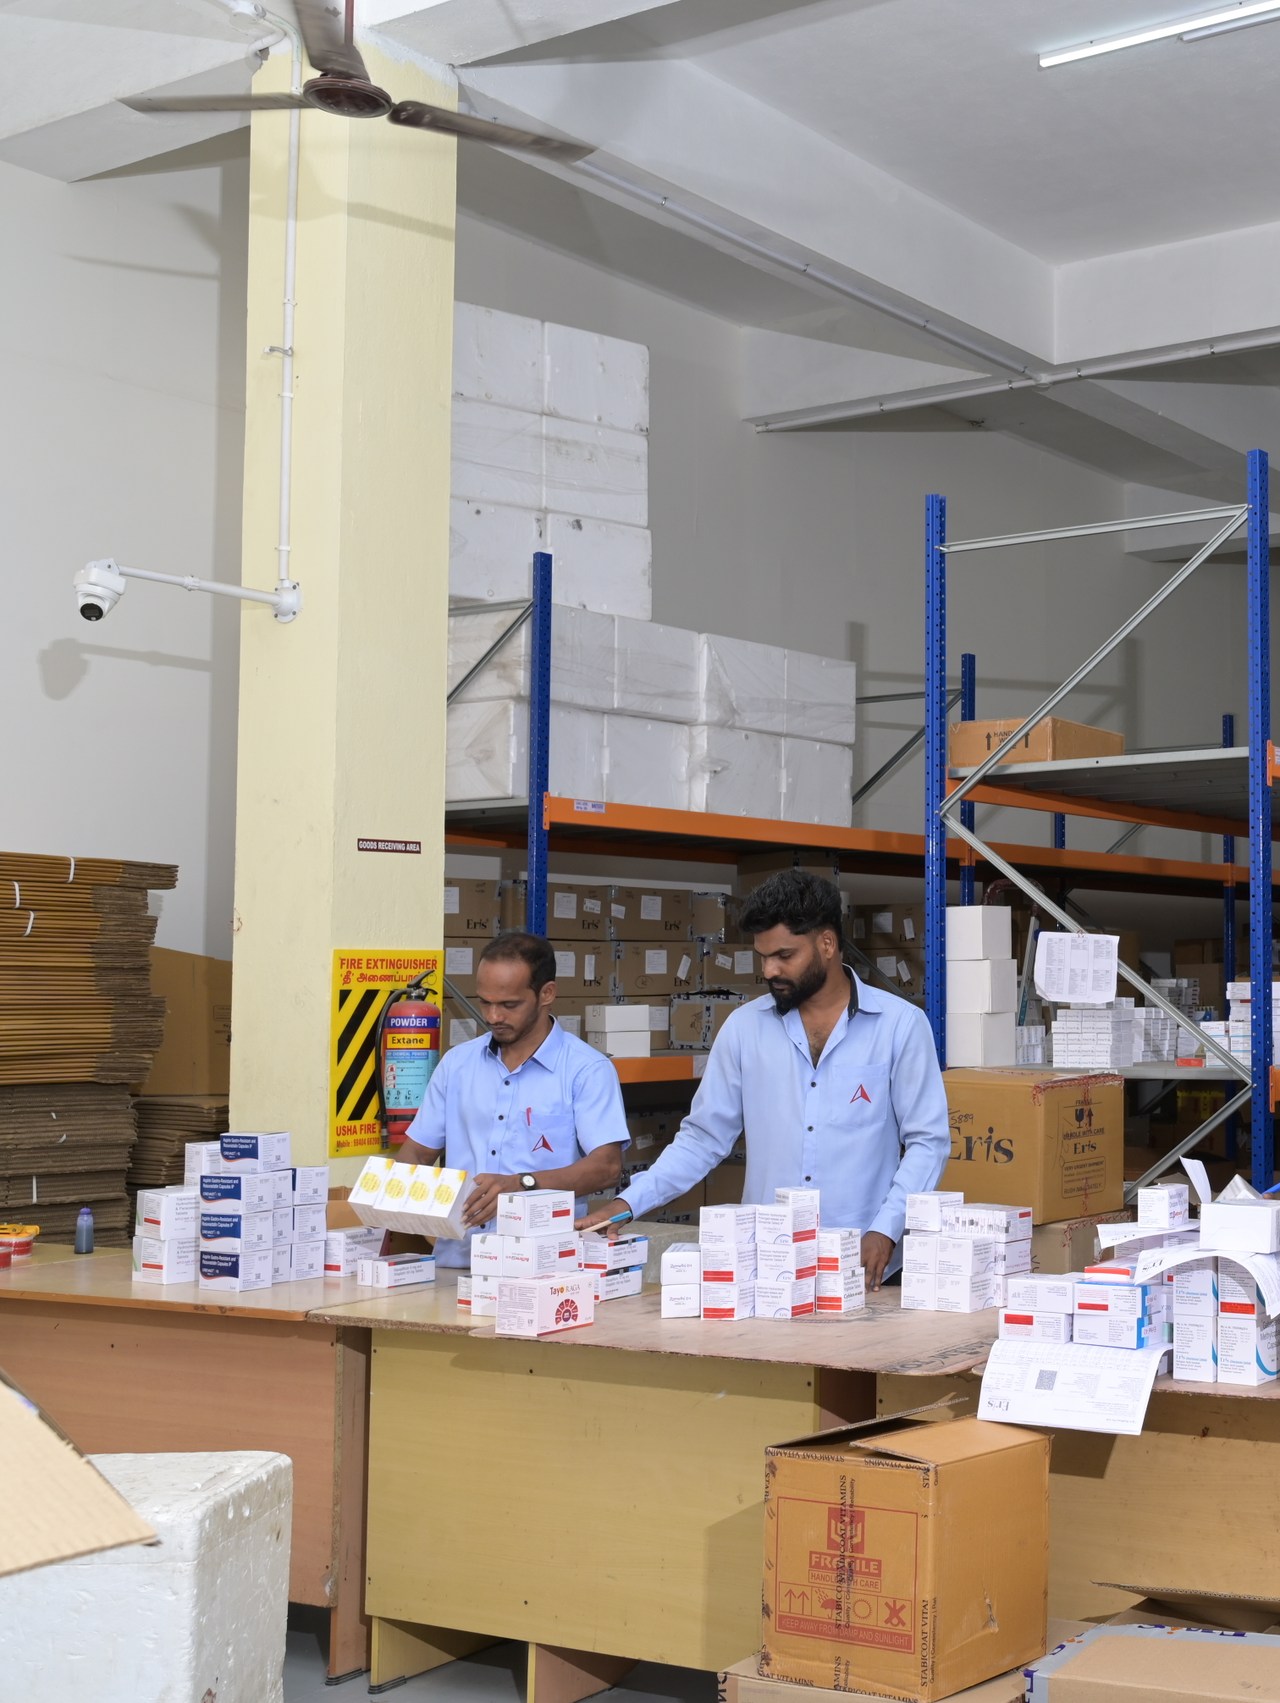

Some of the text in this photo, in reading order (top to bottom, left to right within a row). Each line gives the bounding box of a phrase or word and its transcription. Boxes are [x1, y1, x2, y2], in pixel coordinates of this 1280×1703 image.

[358, 840, 420, 851] GOODS RECEIVING AREA
[467, 919, 487, 929] Eris
[582, 920, 598, 929] Eris
[340, 959, 437, 969] FIRE EXTINGUISHER
[390, 1018, 427, 1026] POWDER
[336, 1123, 376, 1136] USHA FIRE
[1073, 1141, 1097, 1155] Eris
[860, 1580, 879, 1588] CARE
[782, 1619, 908, 1644] KEEP AWAY FROM DAMP AND SUNLIGHT
[777, 1674, 814, 1687] VITAMINS
